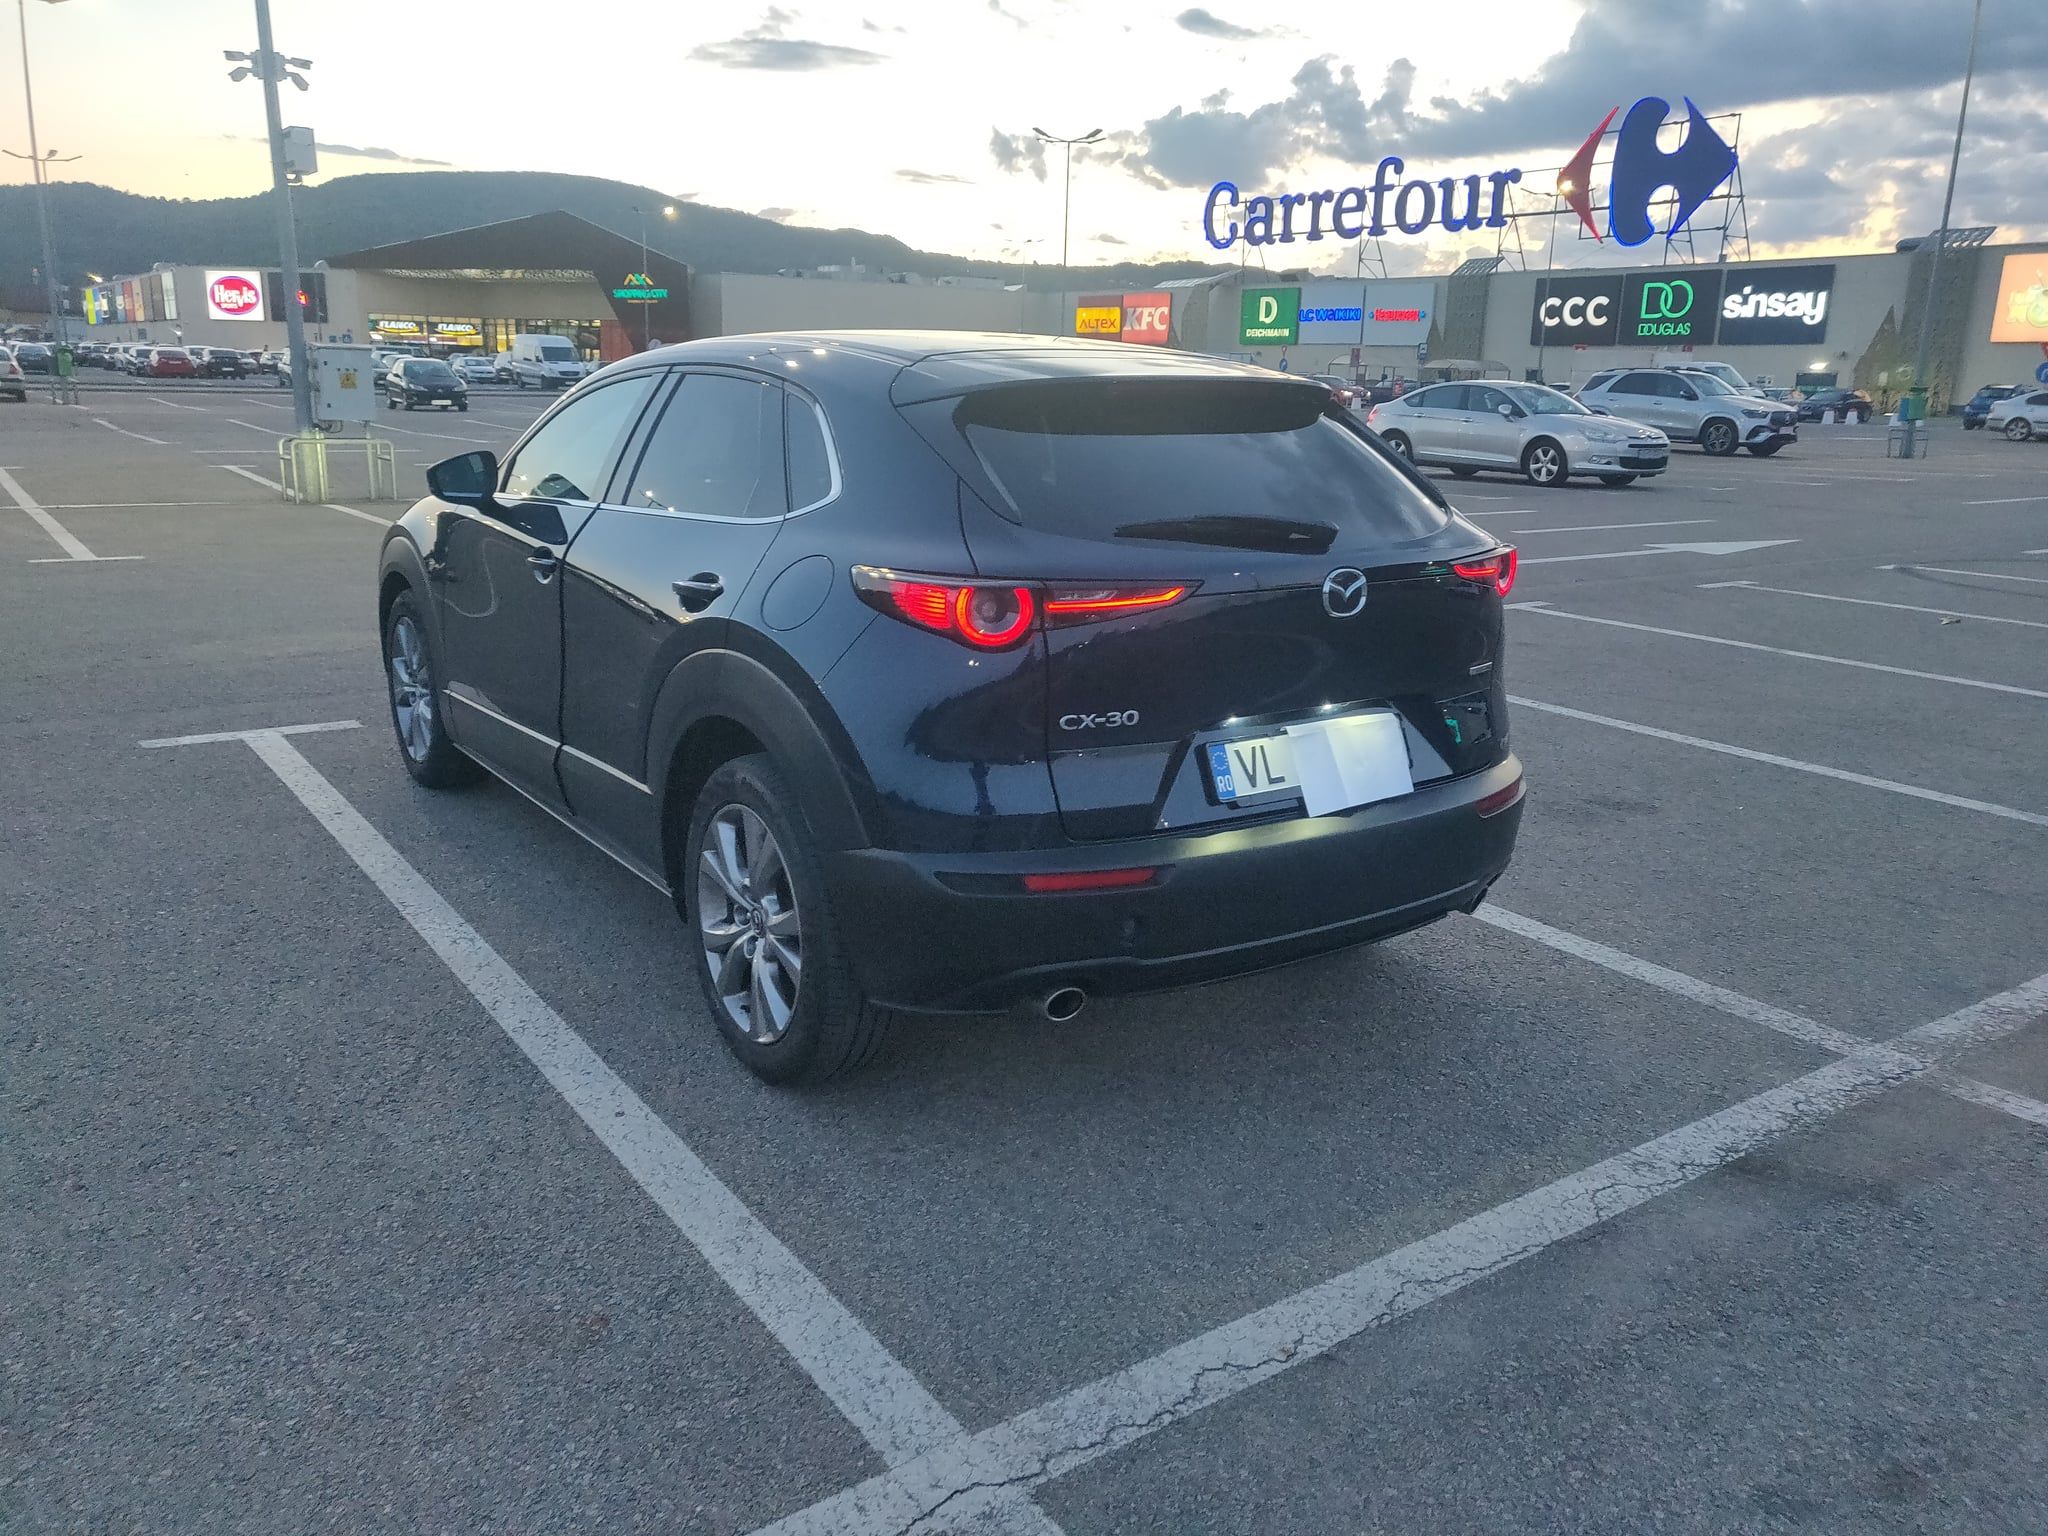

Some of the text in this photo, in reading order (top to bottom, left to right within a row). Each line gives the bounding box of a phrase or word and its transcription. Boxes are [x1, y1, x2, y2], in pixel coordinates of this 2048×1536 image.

[1204, 155, 1522, 249] Carrefour
[213, 285, 257, 307] Hervis
[1722, 285, 1828, 325] sinsay
[1123, 306, 1169, 331] KFC
[1258, 296, 1278, 324] D
[1299, 308, 1314, 322] LC
[1539, 295, 1610, 327] CCC
[379, 320, 416, 330] FLANCO
[437, 323, 474, 332] FLANCO
[1245, 328, 1290, 338] DEICHMANN
[1637, 321, 1691, 337] DOUGLAS
[1059, 709, 1140, 732] CX-30
[1234, 744, 1286, 788] VL
[1216, 775, 1233, 793] RO
